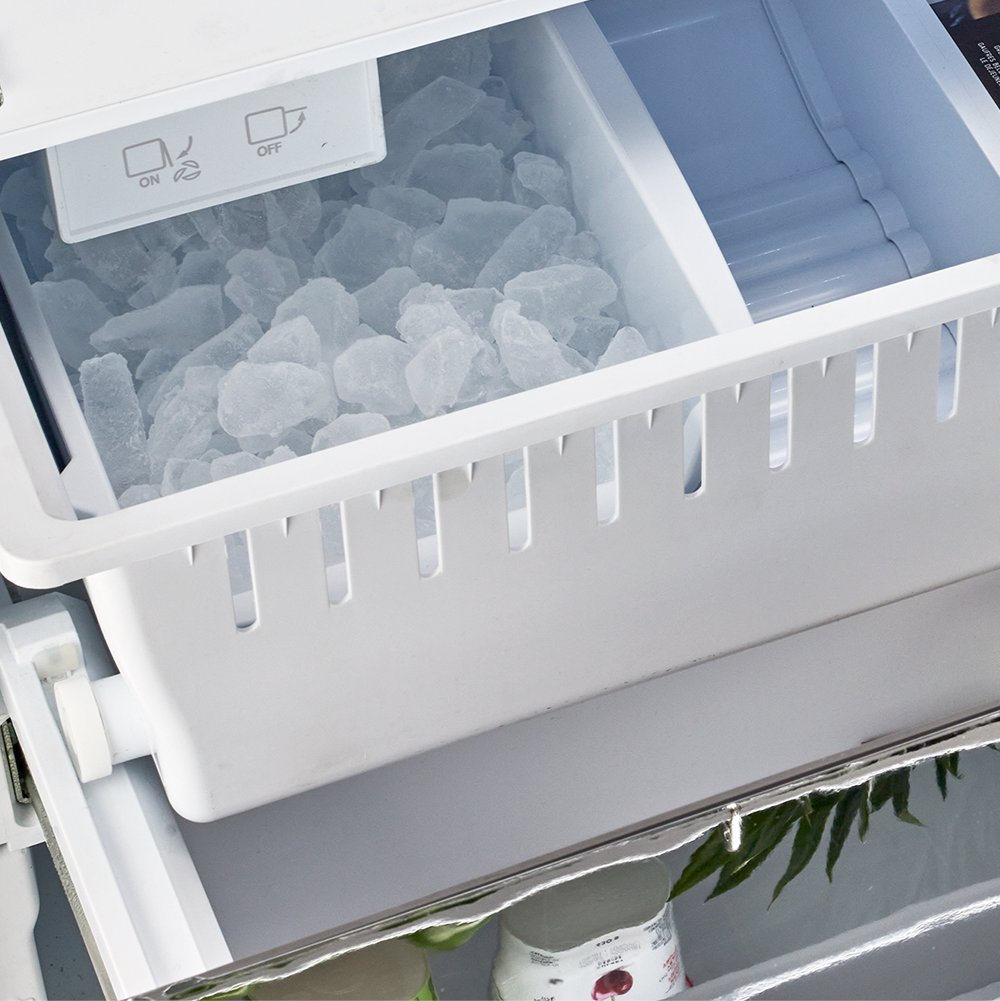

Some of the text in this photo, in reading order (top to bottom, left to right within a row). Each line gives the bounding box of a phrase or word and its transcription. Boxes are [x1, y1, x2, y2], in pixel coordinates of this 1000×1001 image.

[978, 42, 996, 62] GAUFRES
[257, 142, 283, 157] OFF
[139, 174, 161, 189] ON
